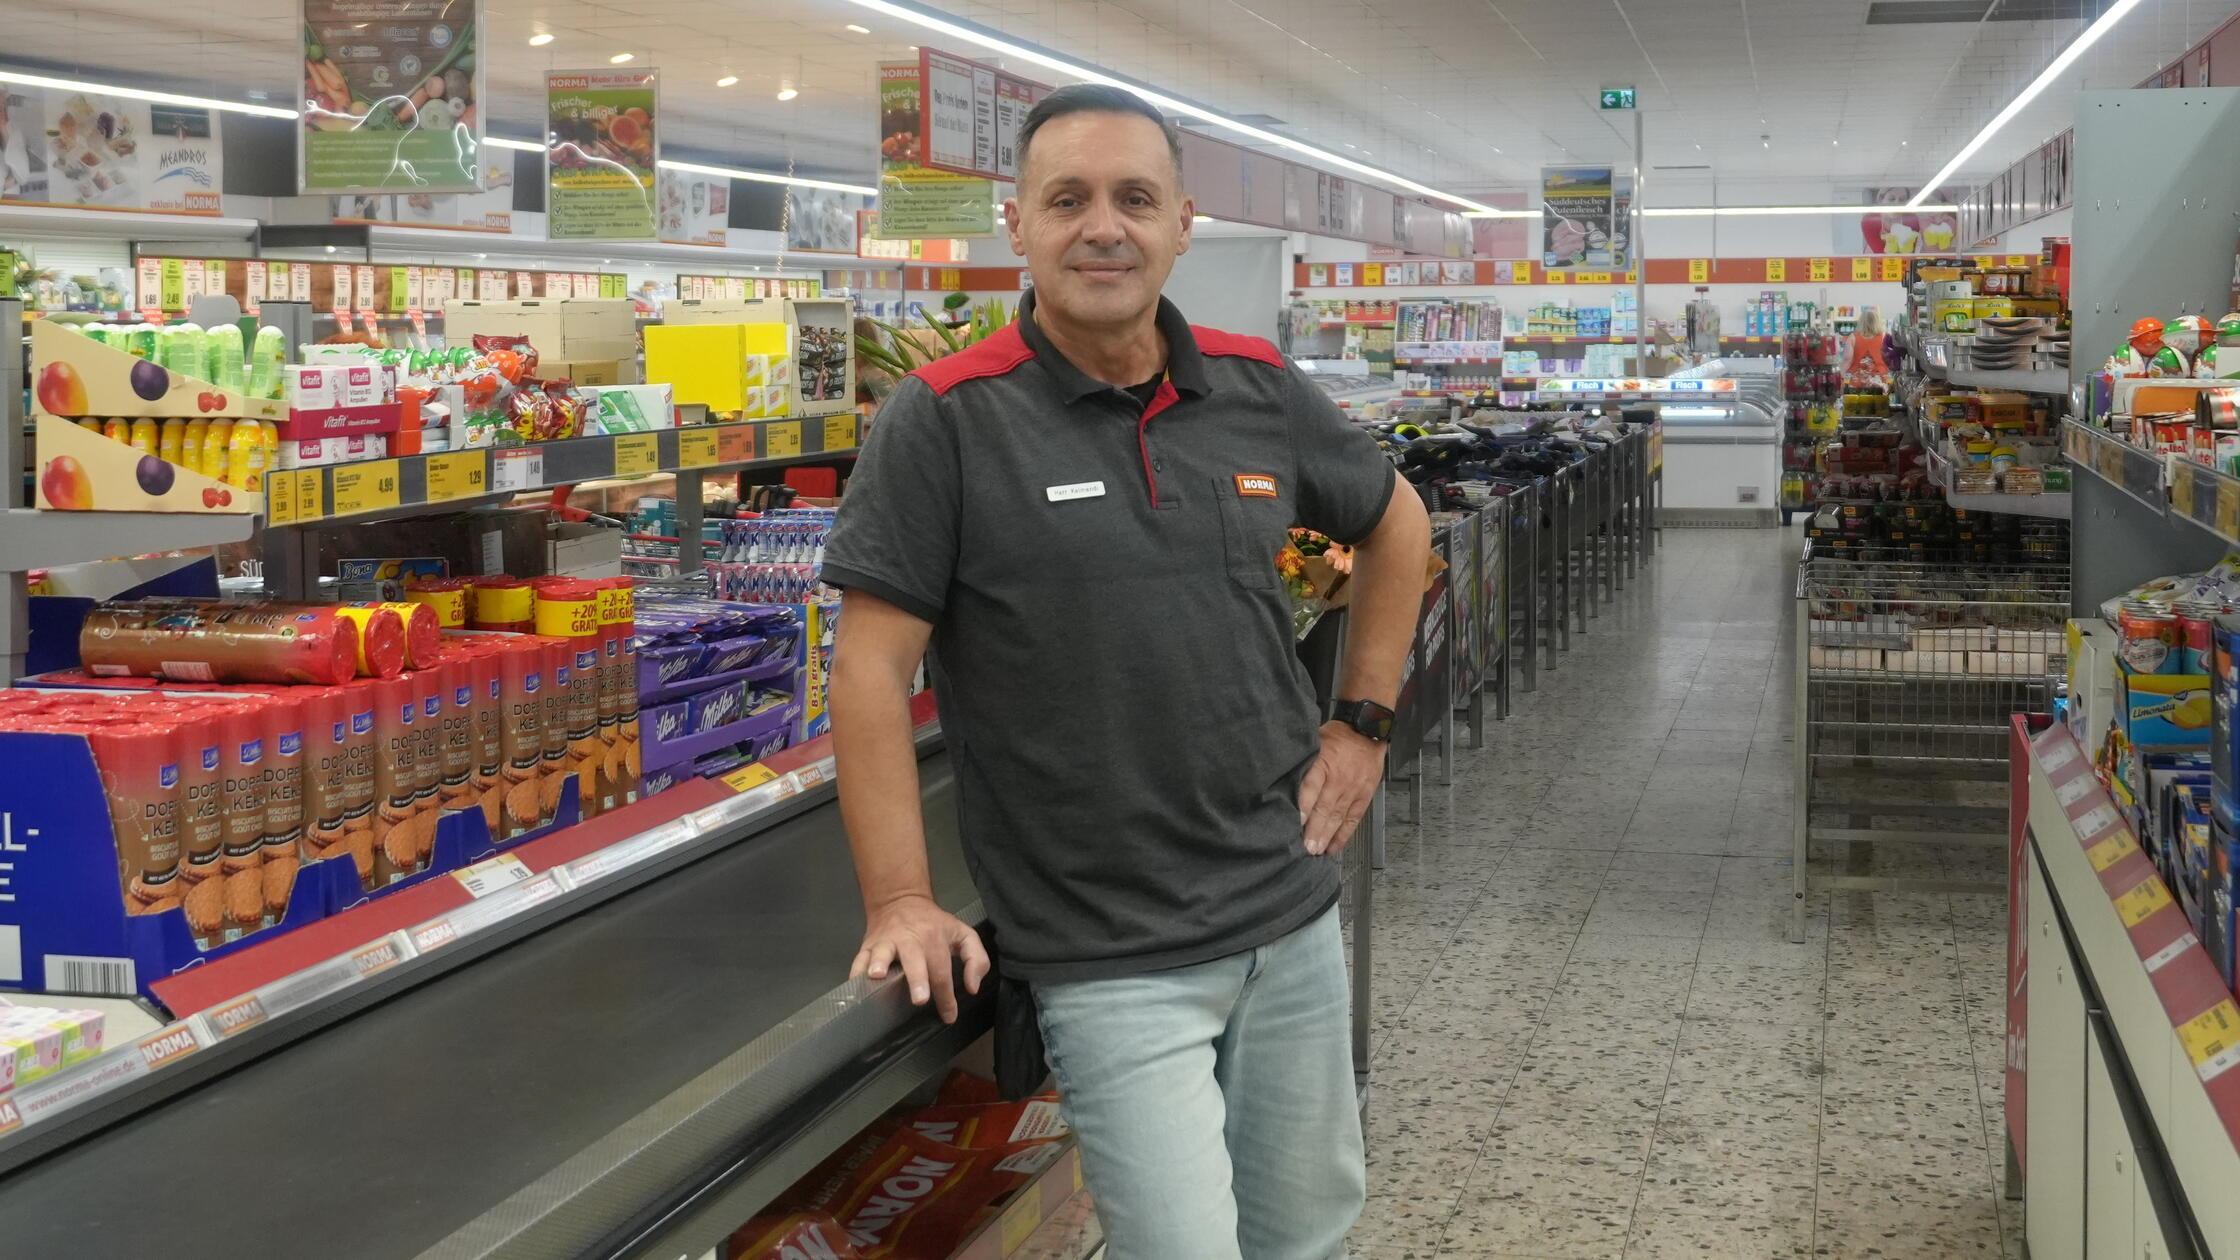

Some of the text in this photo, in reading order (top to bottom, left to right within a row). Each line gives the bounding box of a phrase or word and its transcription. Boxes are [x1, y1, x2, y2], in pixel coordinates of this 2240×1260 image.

[549, 77, 588, 89] NORMA
[881, 69, 920, 79] NORMA
[551, 95, 593, 112] Frischer
[882, 87, 920, 103] Frische
[582, 104, 618, 120] billiger
[160, 147, 208, 169] MEANDROS
[186, 193, 221, 209] NORMA
[1243, 479, 1274, 492] NORMA
[571, 620, 598, 633] GRATI
[658, 654, 689, 684] Milka
[811, 643, 819, 681] gratis
[700, 690, 735, 731] Milka
[2132, 702, 2176, 719] Limonata
[758, 733, 785, 760] Milka
[645, 772, 673, 796] Milka
[357, 944, 397, 972] NORMA
[213, 1000, 264, 1029] NORMA
[142, 1028, 195, 1065] NORMA
[850, 1155, 957, 1247] NORM
